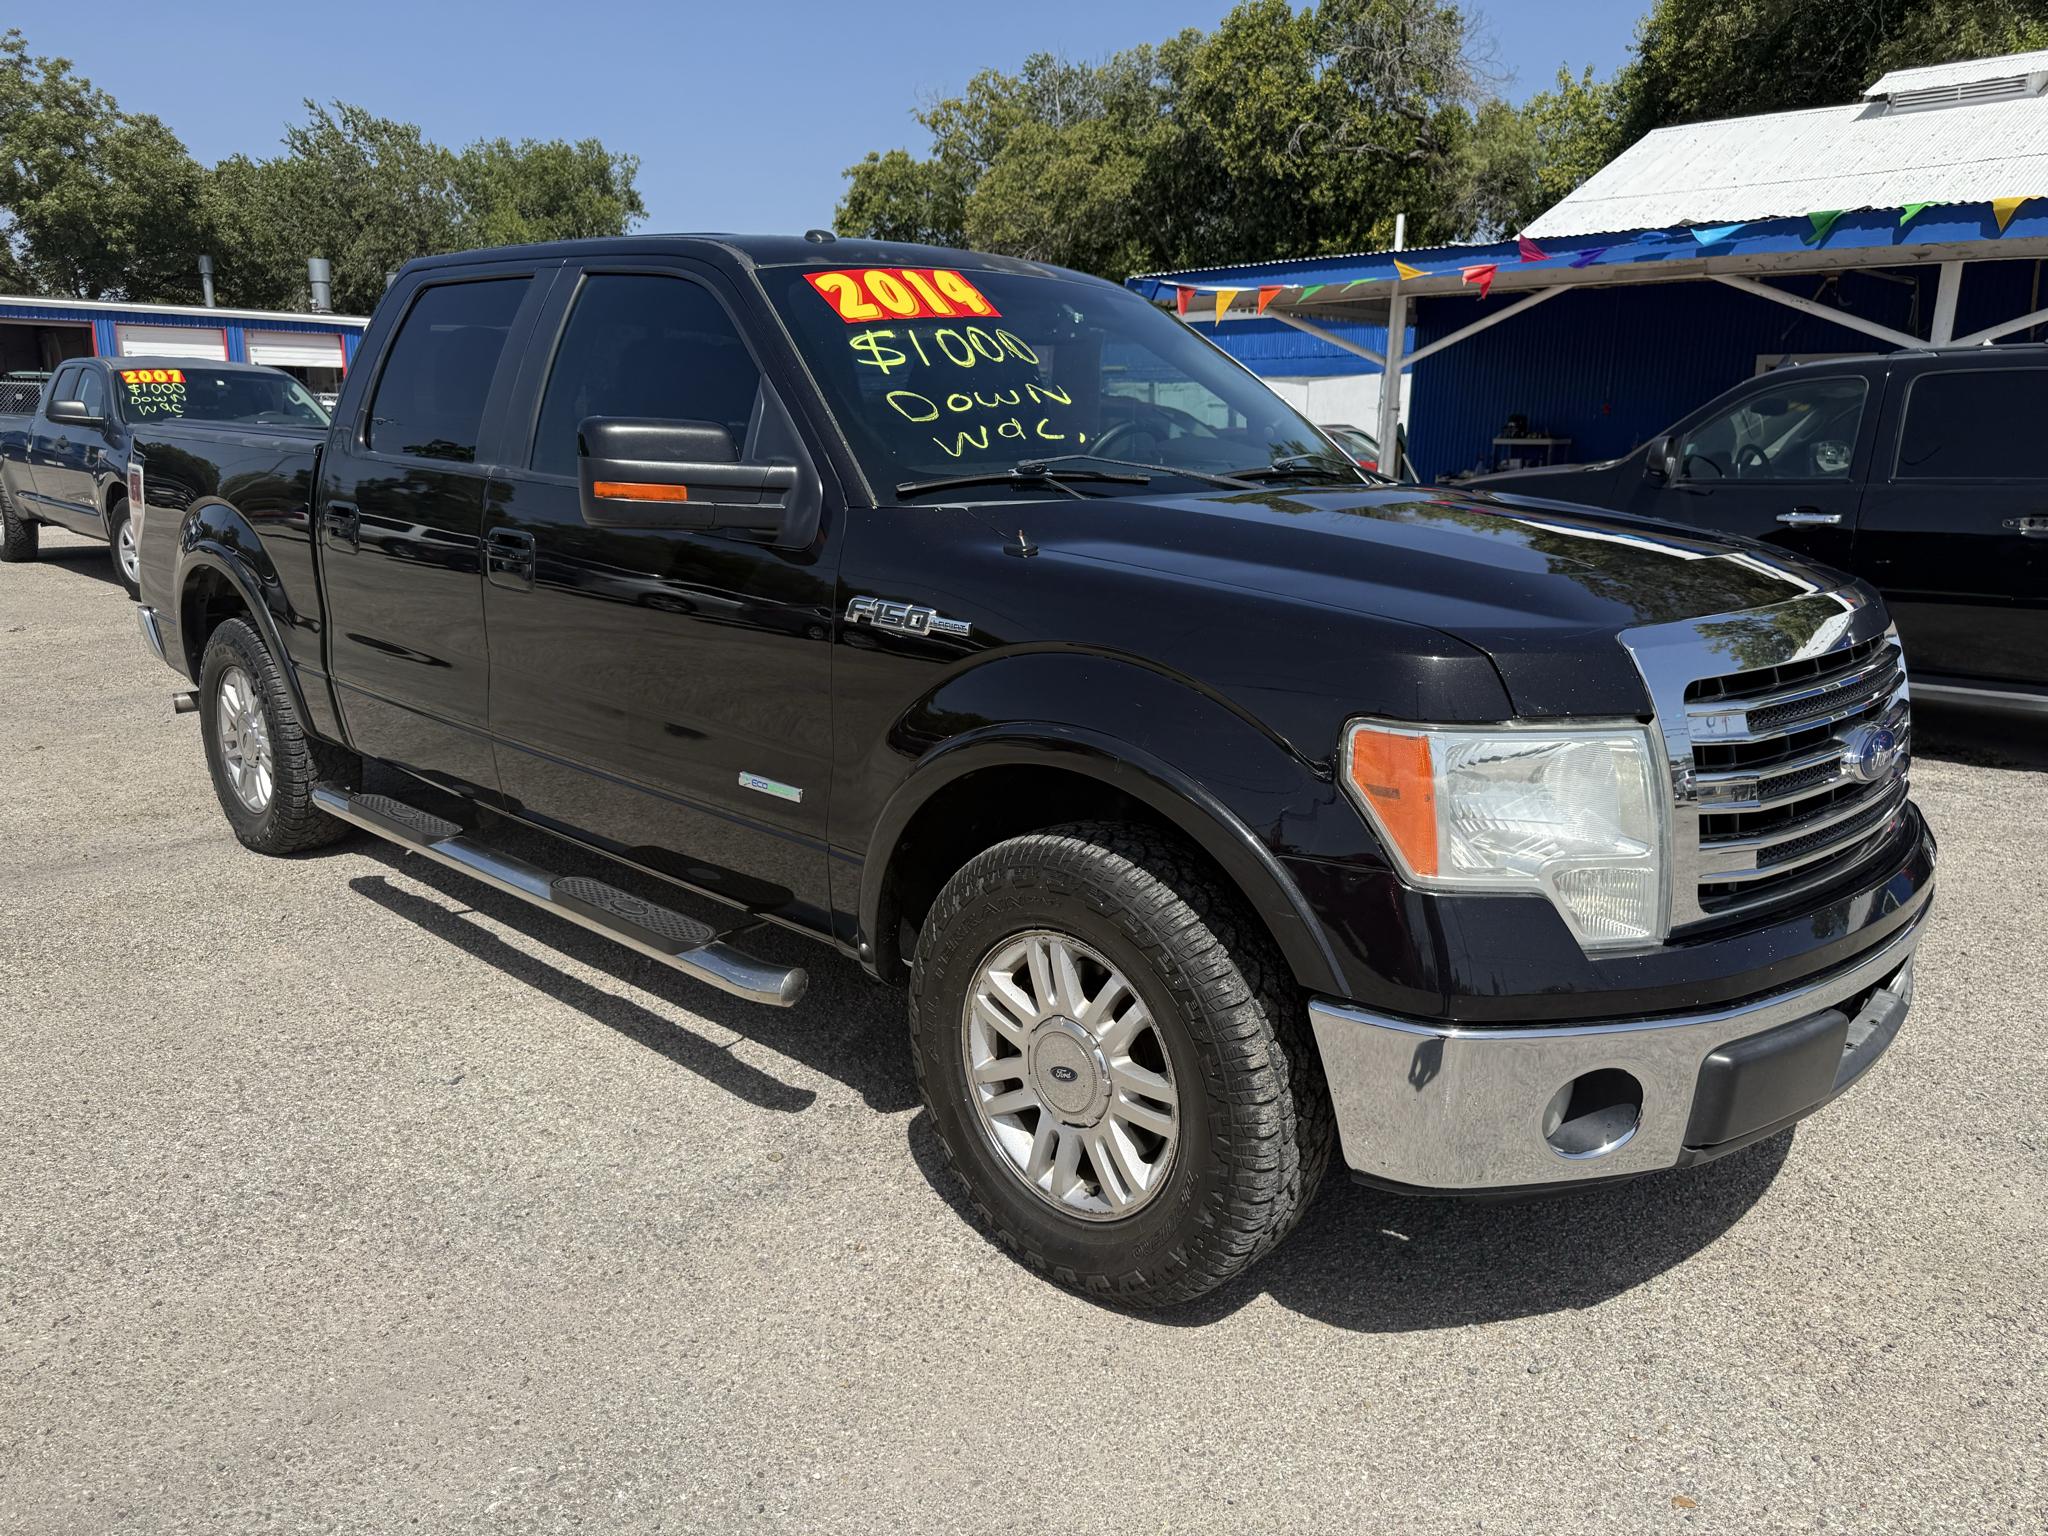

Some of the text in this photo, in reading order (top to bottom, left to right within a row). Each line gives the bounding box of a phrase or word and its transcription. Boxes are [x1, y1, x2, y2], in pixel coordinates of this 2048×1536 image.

[814, 269, 992, 316] 2014
[849, 326, 1040, 375] $1000
[122, 370, 182, 384] 2007
[128, 383, 186, 396] $1000
